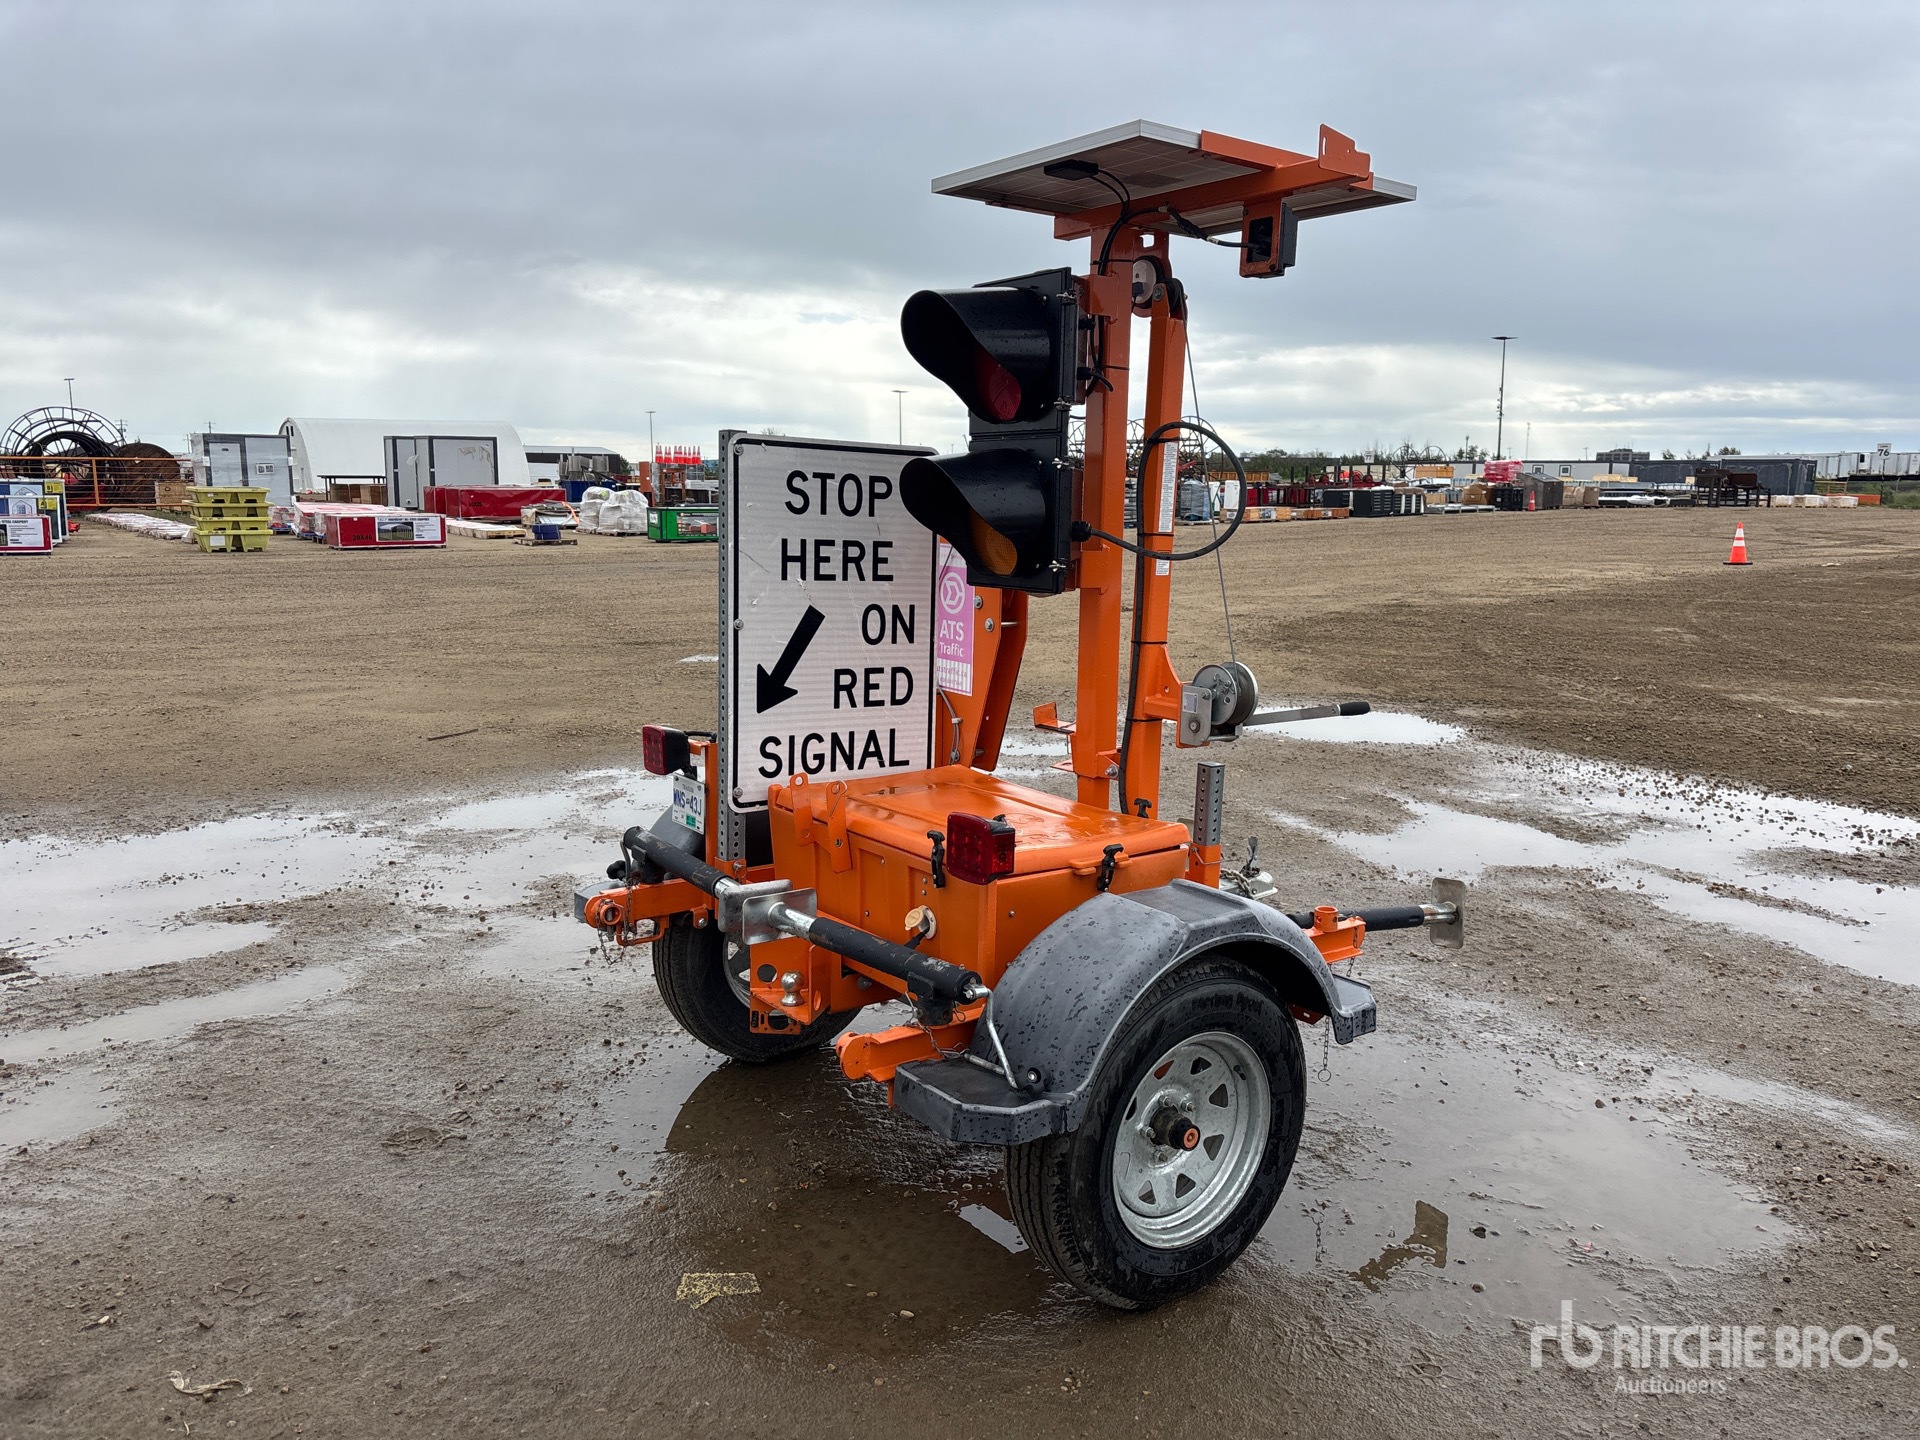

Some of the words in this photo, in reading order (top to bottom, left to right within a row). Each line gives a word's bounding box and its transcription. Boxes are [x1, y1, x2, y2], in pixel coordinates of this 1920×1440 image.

[785, 470, 893, 518] STOP
[781, 538, 894, 582] HERE
[862, 603, 915, 646] ON
[939, 619, 965, 642] ATS
[939, 641, 965, 658] Traffic
[833, 666, 914, 710] RED
[758, 728, 910, 779] SIGNAL
